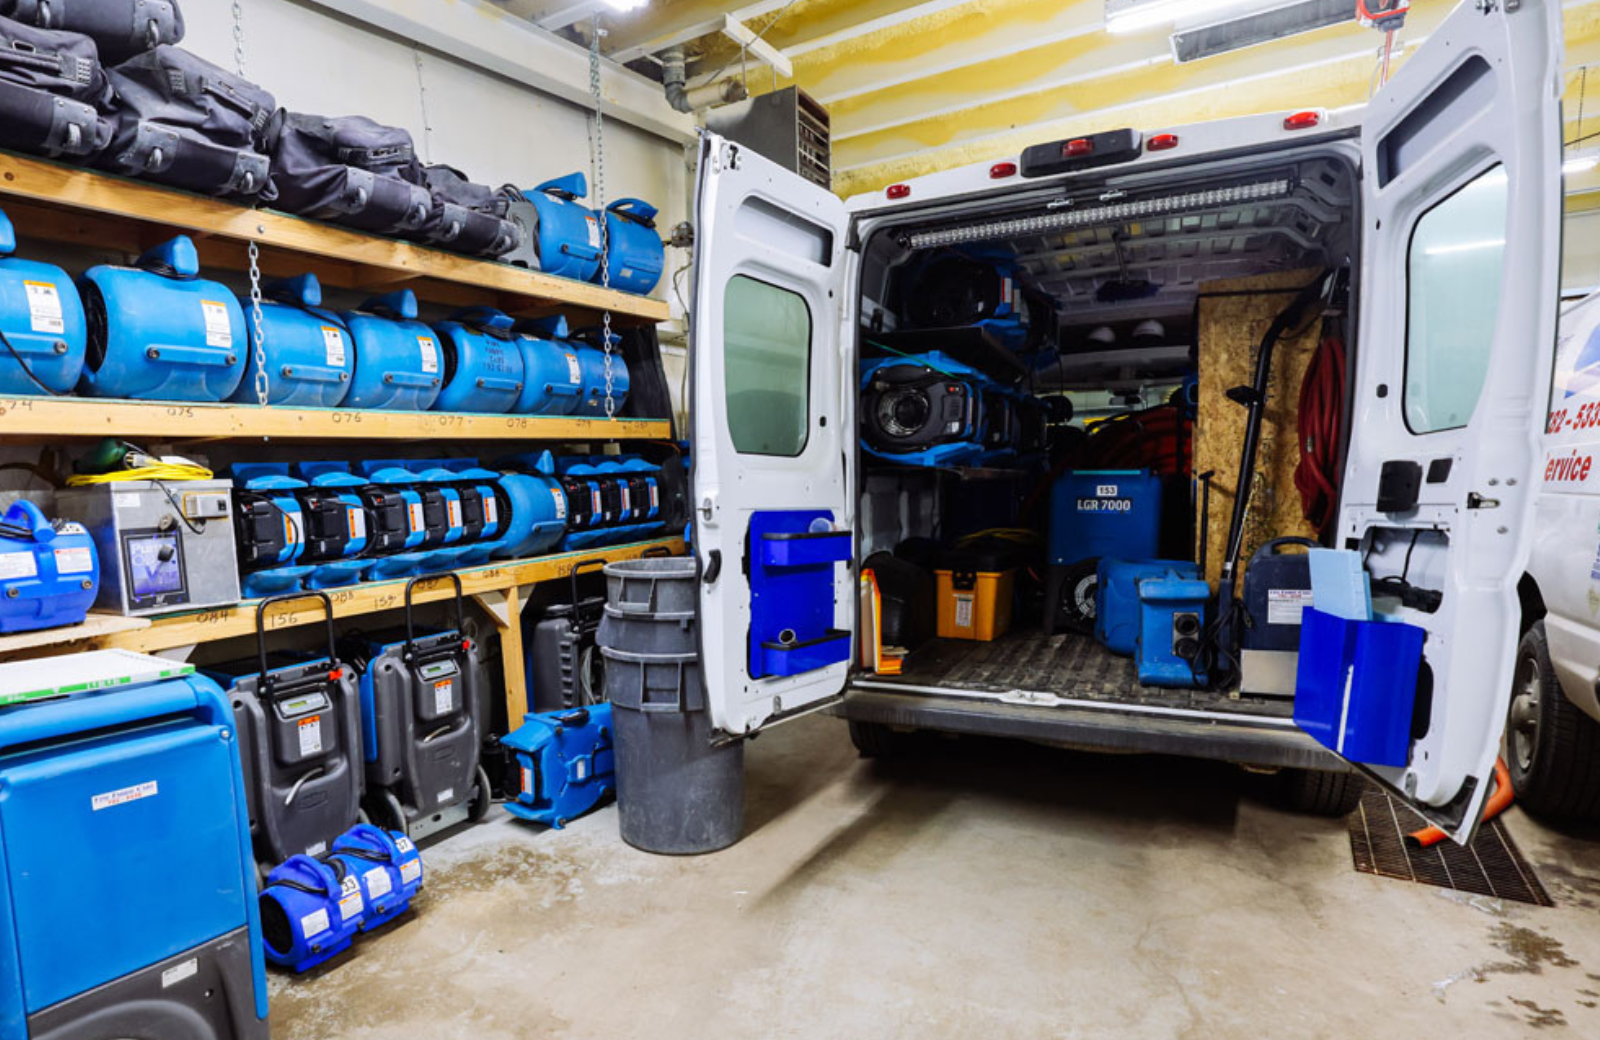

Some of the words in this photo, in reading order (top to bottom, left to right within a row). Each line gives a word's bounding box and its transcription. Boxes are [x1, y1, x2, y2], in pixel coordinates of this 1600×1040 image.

[331, 412, 363, 424] 076
[1544, 449, 1593, 482] ervice
[1099, 486, 1116, 495] 153
[1076, 499, 1099, 511] LGR
[1101, 499, 1131, 511] 7000
[271, 611, 298, 628] 156
